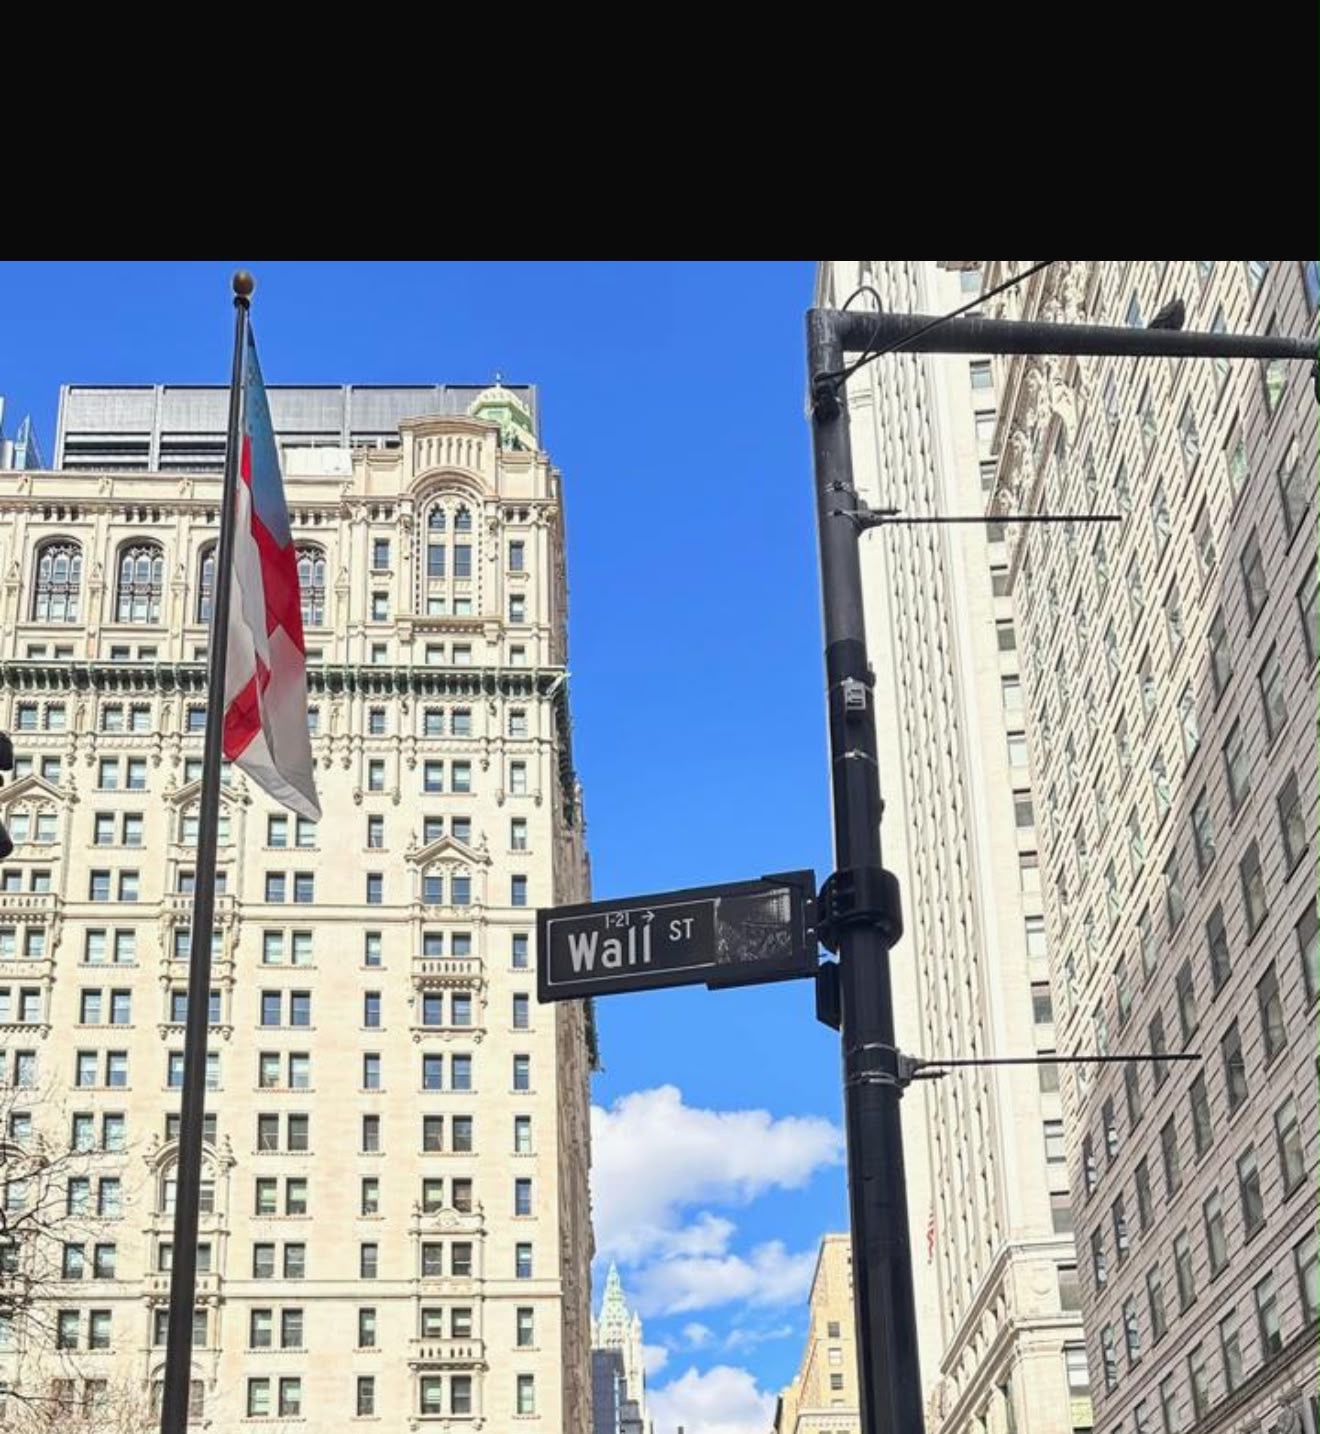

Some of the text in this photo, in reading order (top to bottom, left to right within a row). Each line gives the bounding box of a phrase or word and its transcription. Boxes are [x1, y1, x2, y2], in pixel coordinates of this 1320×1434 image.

[605, 913, 630, 928] 1-21
[568, 918, 694, 973] Wall ST
